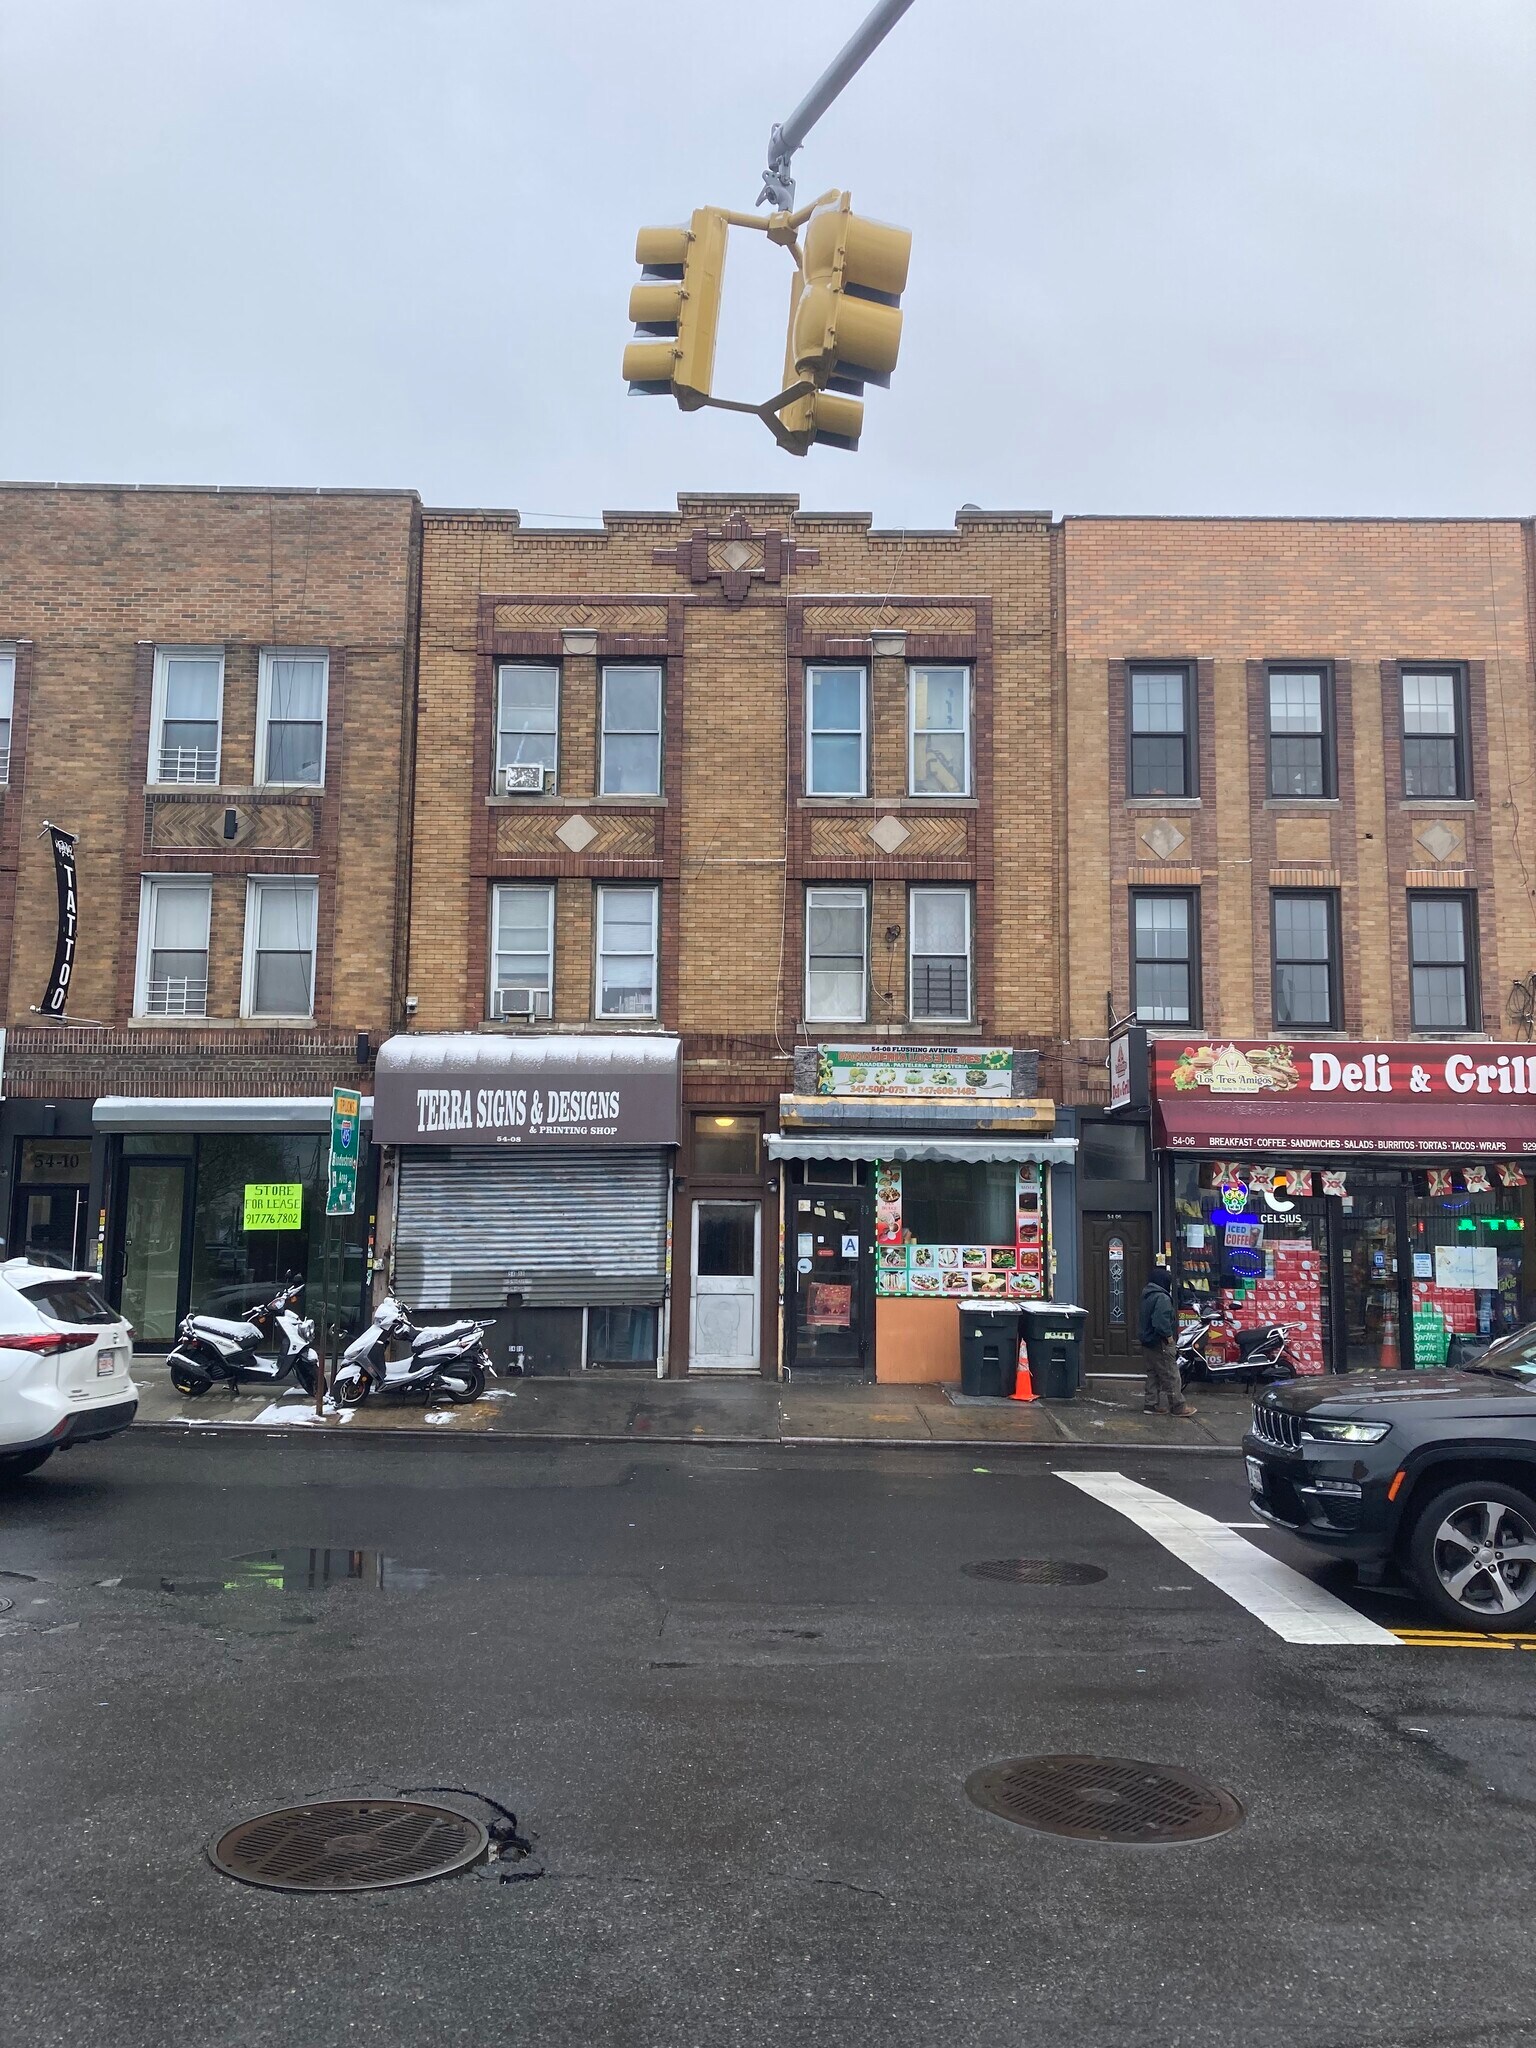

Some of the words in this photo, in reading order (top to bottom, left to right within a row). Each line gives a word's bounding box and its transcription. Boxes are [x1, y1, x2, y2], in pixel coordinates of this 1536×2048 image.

[51, 864, 76, 1010] TATTOO
[838, 1051, 908, 1063] PANADERIA
[943, 1053, 982, 1064] REYES
[1309, 1052, 1393, 1092] Deli
[1410, 1064, 1432, 1093] &
[1444, 1053, 1536, 1094] Grill
[1196, 1074, 1214, 1083] Los
[1216, 1074, 1237, 1083] Tres
[1239, 1074, 1273, 1086] Amigos
[416, 1089, 473, 1132] TERRA
[476, 1088, 527, 1128] SIGNS
[530, 1089, 543, 1125] &
[547, 1090, 620, 1123] DESIGNS
[529, 1126, 537, 1134] &
[539, 1126, 588, 1135] PRINTING
[590, 1126, 618, 1135] SHOP
[496, 1135, 522, 1143] 54-08
[1172, 1136, 1196, 1145] 54-06
[1209, 1137, 1253, 1147] BREAKFAST
[1256, 1138, 1287, 1147] COFFEE
[1290, 1139, 1341, 1148] SANDWICHES
[1344, 1140, 1374, 1149] SALADS
[1378, 1140, 1415, 1149] BURRITOS
[1418, 1141, 1447, 1150] TORTAS
[1451, 1141, 1475, 1150] TACOS
[1478, 1141, 1506, 1150] WRAPS
[1522, 1142, 1536, 1151] 929
[34, 1153, 80, 1168] 54-10
[254, 1185, 294, 1196] STORE
[245, 1199, 264, 1209] FOR
[267, 1199, 301, 1209] LEASE
[1260, 1214, 1302, 1223] CELSIUS
[1228, 1225, 1247, 1233] ICED
[845, 1238, 857, 1251] A
[1414, 1322, 1438, 1331] Sprite
[1414, 1333, 1438, 1342] Sprite
[1414, 1343, 1438, 1352] Sprite
[1414, 1353, 1438, 1363] Sprite
